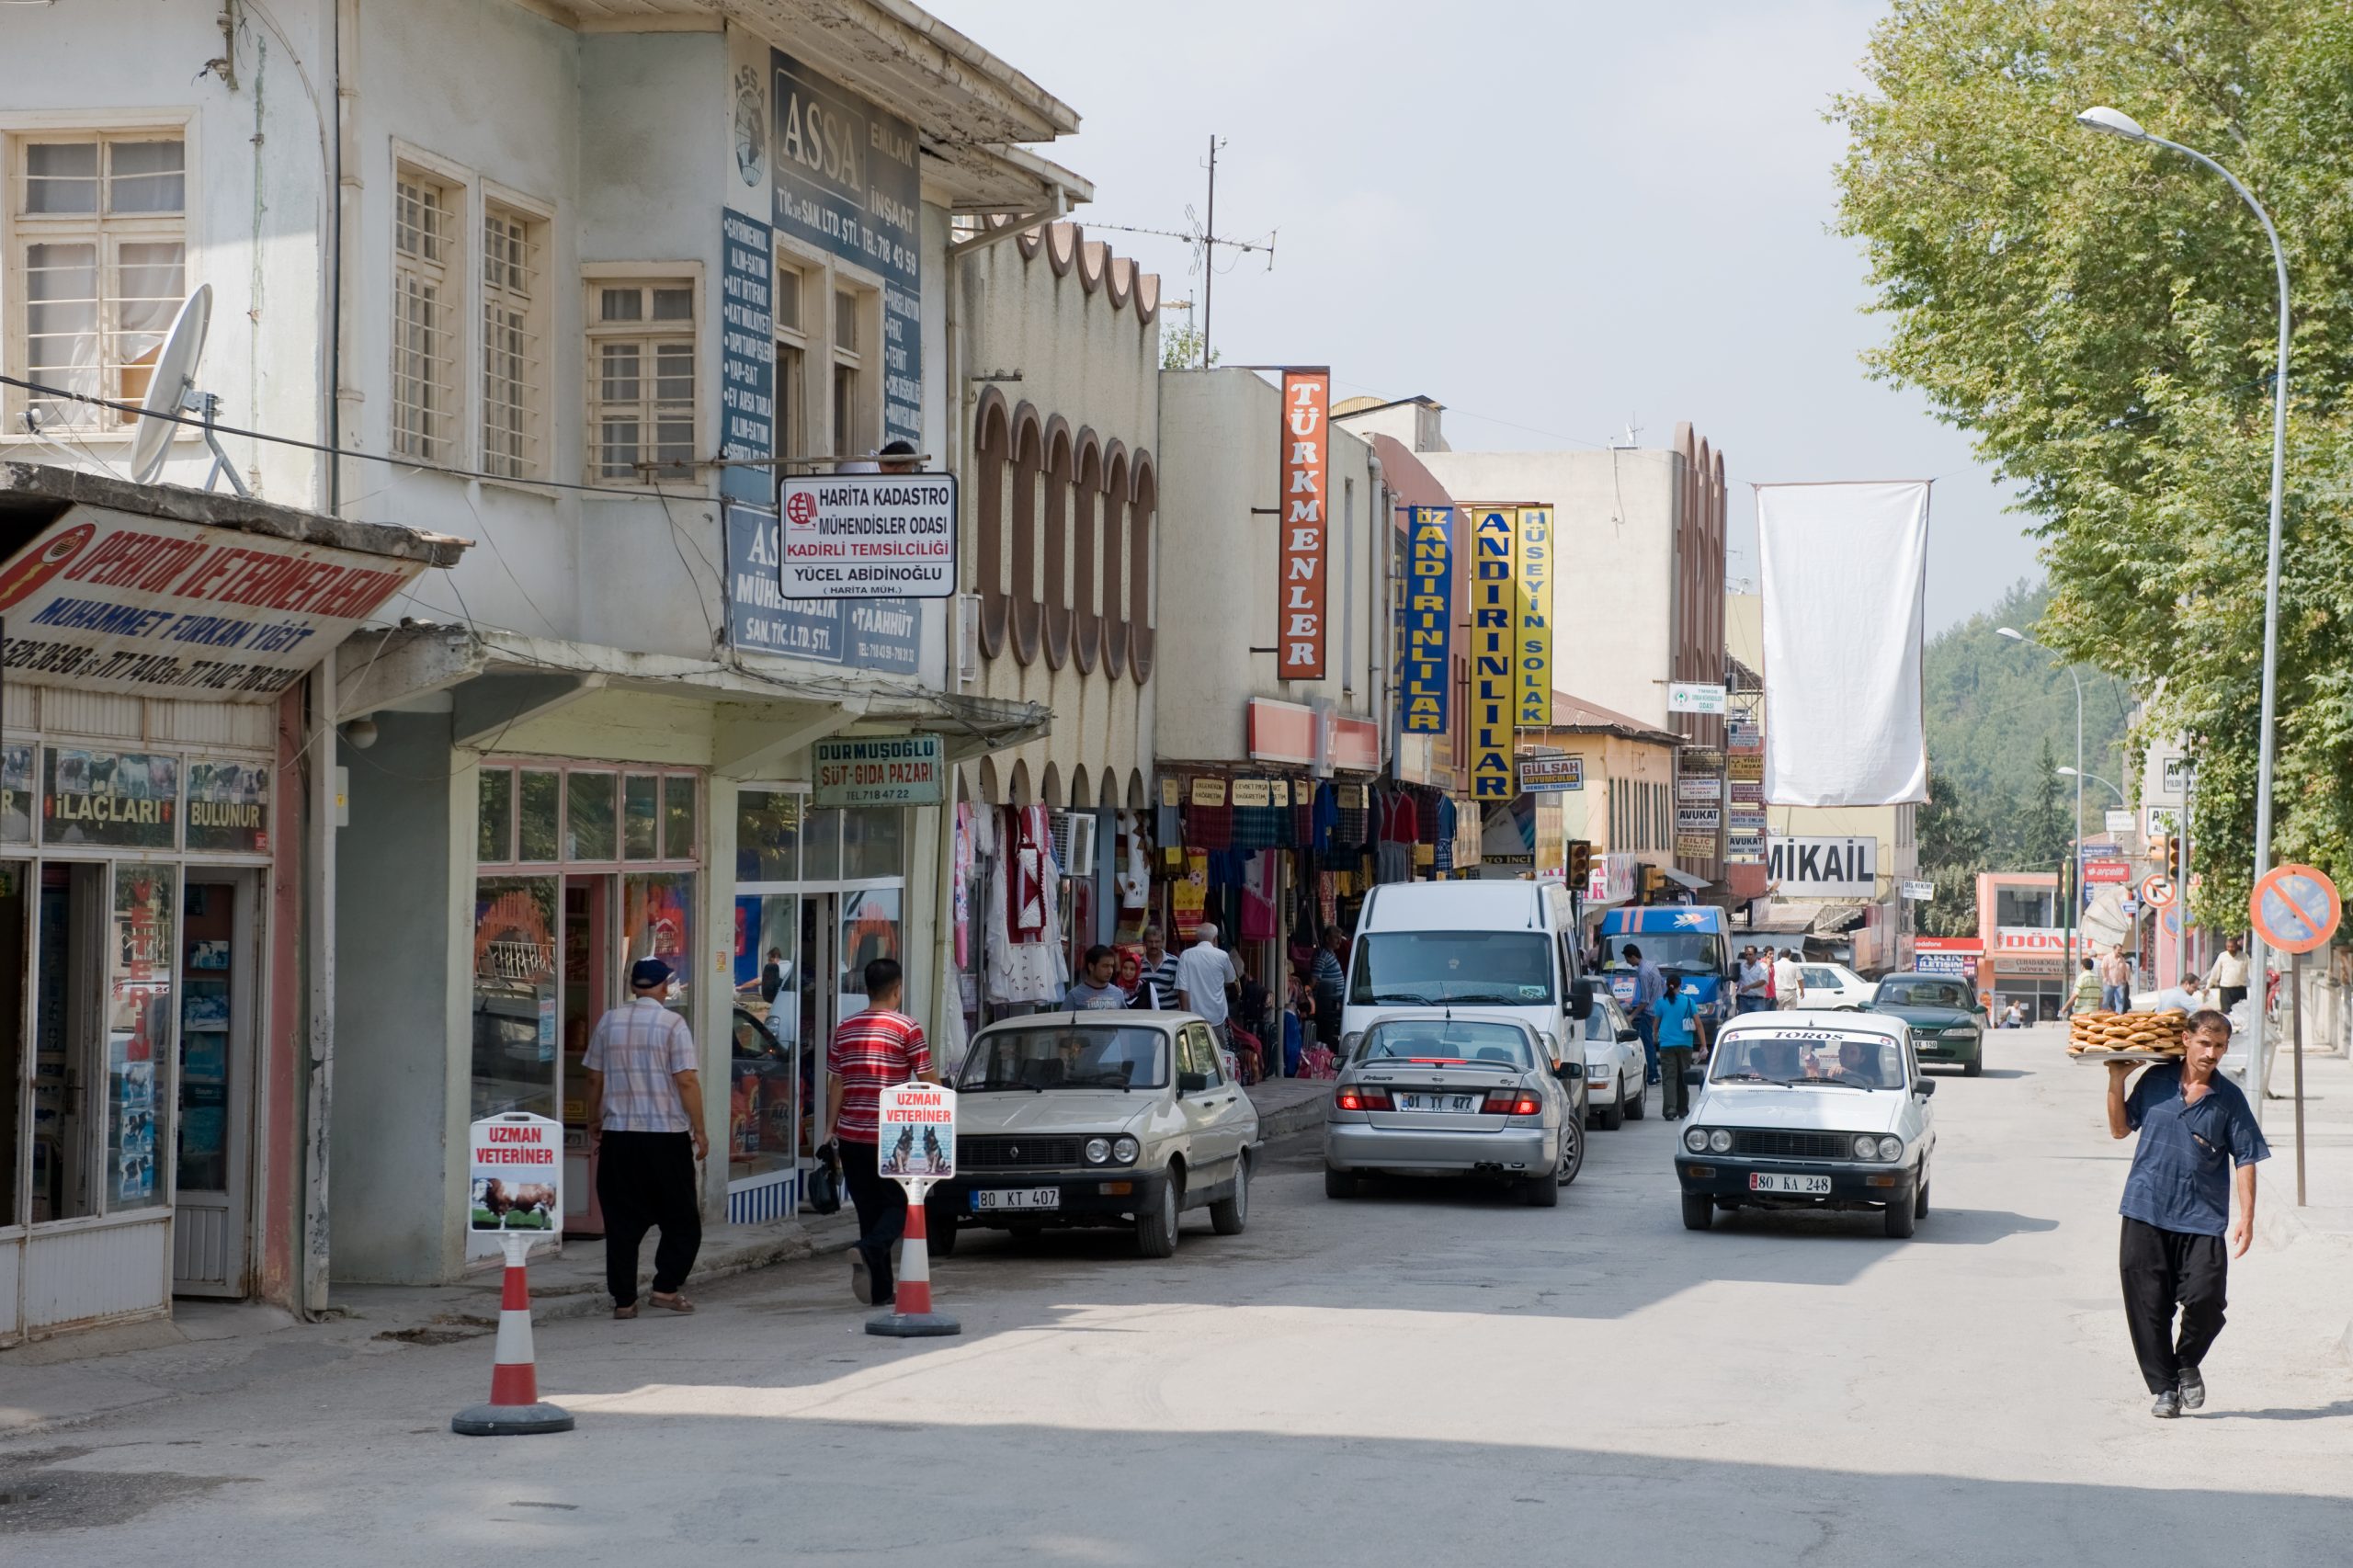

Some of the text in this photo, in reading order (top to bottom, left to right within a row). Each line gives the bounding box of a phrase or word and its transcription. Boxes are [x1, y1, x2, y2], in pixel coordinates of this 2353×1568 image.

[783, 92, 861, 193] ASSA
[870, 121, 914, 168] EMLAK
[870, 185, 915, 234] İNŞAAT
[878, 235, 891, 264] 718
[892, 244, 904, 267] 43
[905, 253, 916, 276] 59
[728, 274, 741, 297] KAT
[728, 301, 741, 325] KAT
[729, 359, 758, 386] YAP-SAT
[728, 386, 737, 408] EV
[739, 390, 755, 413] ARSA
[819, 483, 949, 506] HARİTA KADASTRO
[819, 513, 948, 535] MÜHENDİSLER ODASI
[1286, 382, 1321, 665] TÜRKMENLER
[787, 540, 949, 557] KADİRLİ TEMSİLCİLİĞİ
[63, 529, 408, 619] OPERATÖR VETERİNER HEKİM
[794, 564, 942, 582] YÜCEL ABİDİNOĞLU
[29, 596, 316, 653] MUHAMMET FURKAN YİĞİT
[857, 608, 914, 638] TAAHHÜT
[1408, 508, 1448, 730] ÖZ ANDIRINLILAR
[1521, 511, 1545, 722] HÜSEYİN SOLAK
[745, 617, 769, 642] SAN.
[771, 619, 789, 645] TİC.
[1474, 513, 1512, 796] ANDIRINLILAR
[819, 739, 935, 761] DURMUŞOĞLU
[889, 762, 934, 784] PAZARI
[1524, 774, 1578, 784] KUYUMCULUK
[881, 790, 894, 800] 47
[896, 790, 909, 799] 22
[190, 801, 260, 827] BULUNUR
[1678, 810, 1719, 819] AVUKAT
[1729, 837, 1764, 846] AVUKAT
[1772, 1030, 1845, 1040] TOROS
[896, 1093, 941, 1106] UZMAN
[1407, 1093, 1472, 1108] 01 TY 477
[886, 1108, 951, 1123] VETERİNER
[489, 1127, 542, 1143] UZMAN
[476, 1145, 554, 1165] VETERİNER
[1758, 1175, 1829, 1192] 80 KA 248
[980, 1190, 1056, 1207] 80 KT 407
